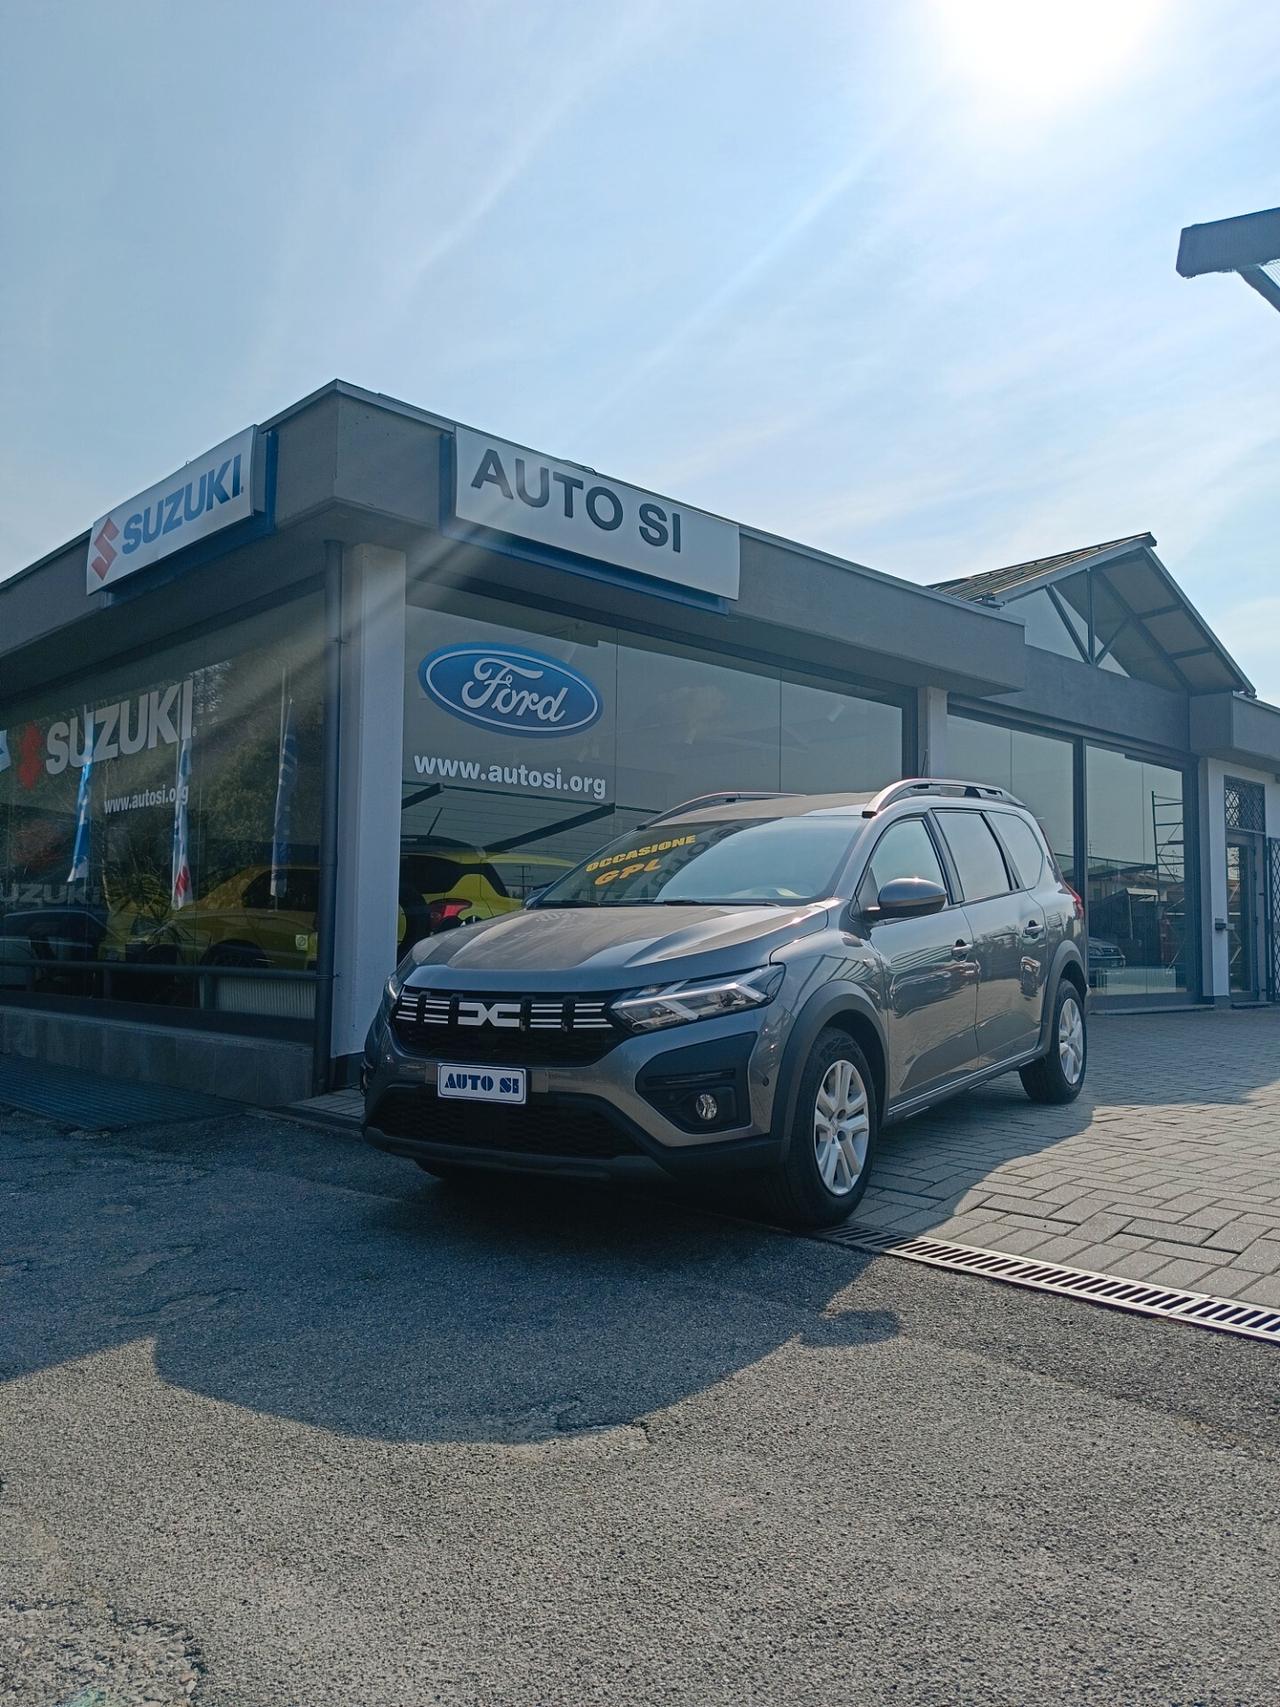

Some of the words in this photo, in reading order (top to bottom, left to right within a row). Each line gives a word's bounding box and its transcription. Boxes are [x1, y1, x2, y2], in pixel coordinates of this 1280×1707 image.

[122, 453, 242, 555] SUZUKI
[470, 448, 624, 531] AUTO
[639, 503, 681, 553] SI
[462, 657, 569, 722] Ford
[46, 678, 194, 775] SUZUKI
[414, 755, 606, 799] www.autosi.org
[586, 834, 696, 872] OCCASIONE
[594, 858, 661, 886] GPL
[444, 1072, 494, 1092] AUTO
[499, 1077, 519, 1094] SI
